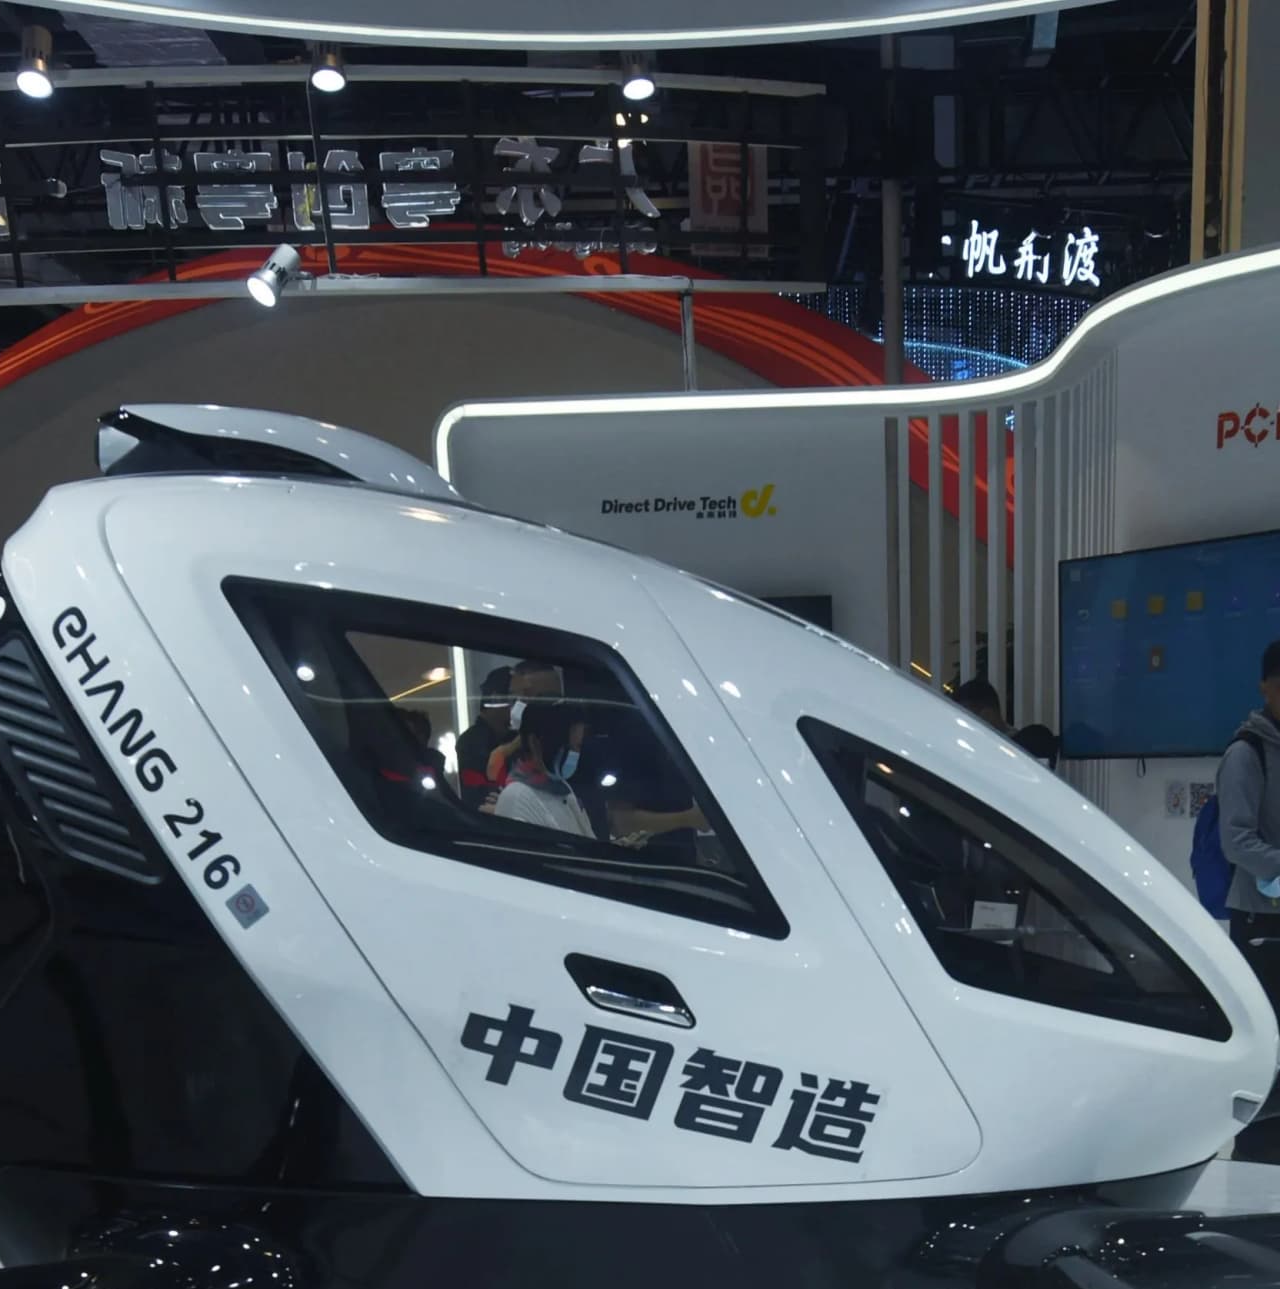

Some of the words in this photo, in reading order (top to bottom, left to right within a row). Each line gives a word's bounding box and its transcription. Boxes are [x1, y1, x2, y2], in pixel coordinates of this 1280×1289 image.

[601, 499, 649, 514] Direct
[654, 497, 695, 512] Drive
[699, 496, 737, 511] Tech
[163, 797, 241, 890] 216
[460, 1002, 882, 1164] 中国智造
